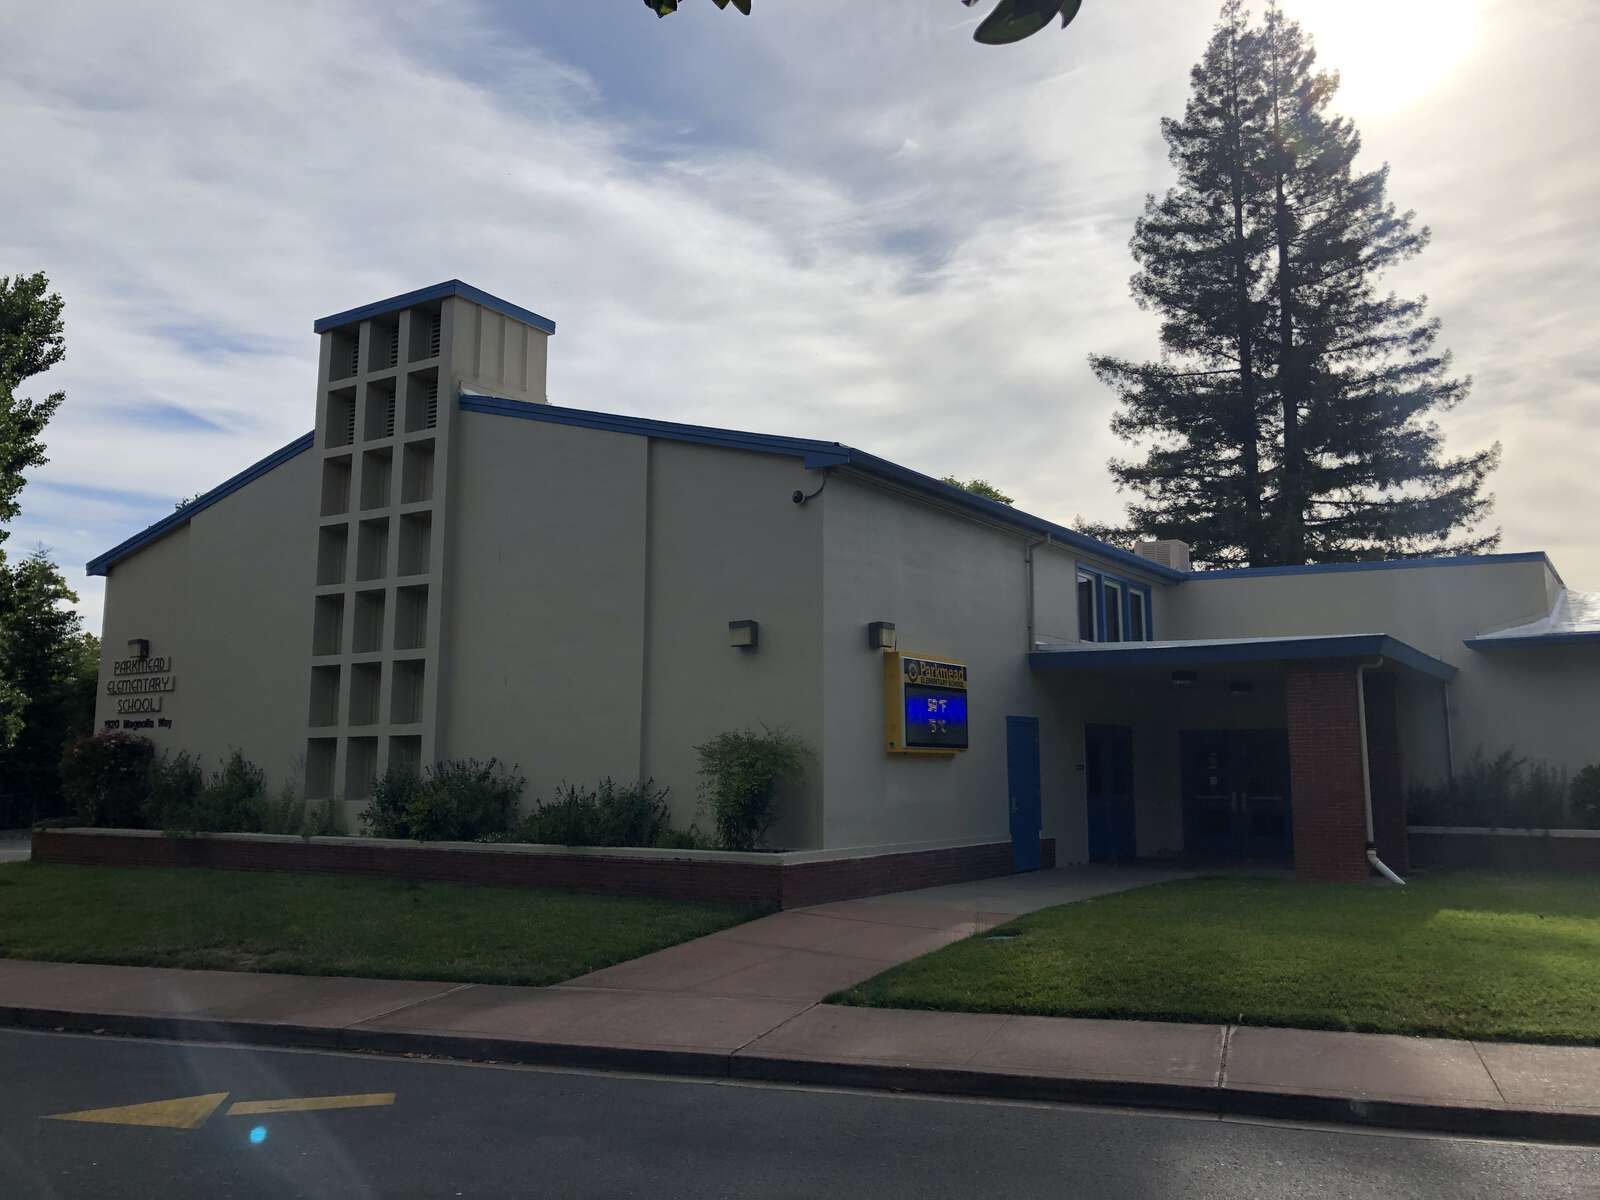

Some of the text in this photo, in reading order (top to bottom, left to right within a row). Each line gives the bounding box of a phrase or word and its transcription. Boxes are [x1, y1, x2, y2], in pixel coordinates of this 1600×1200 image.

[920, 662, 964, 681] Parkmead
[107, 676, 169, 693] ELEMENTARY
[118, 697, 155, 712] SCHOOL
[158, 718, 172, 730] Way
